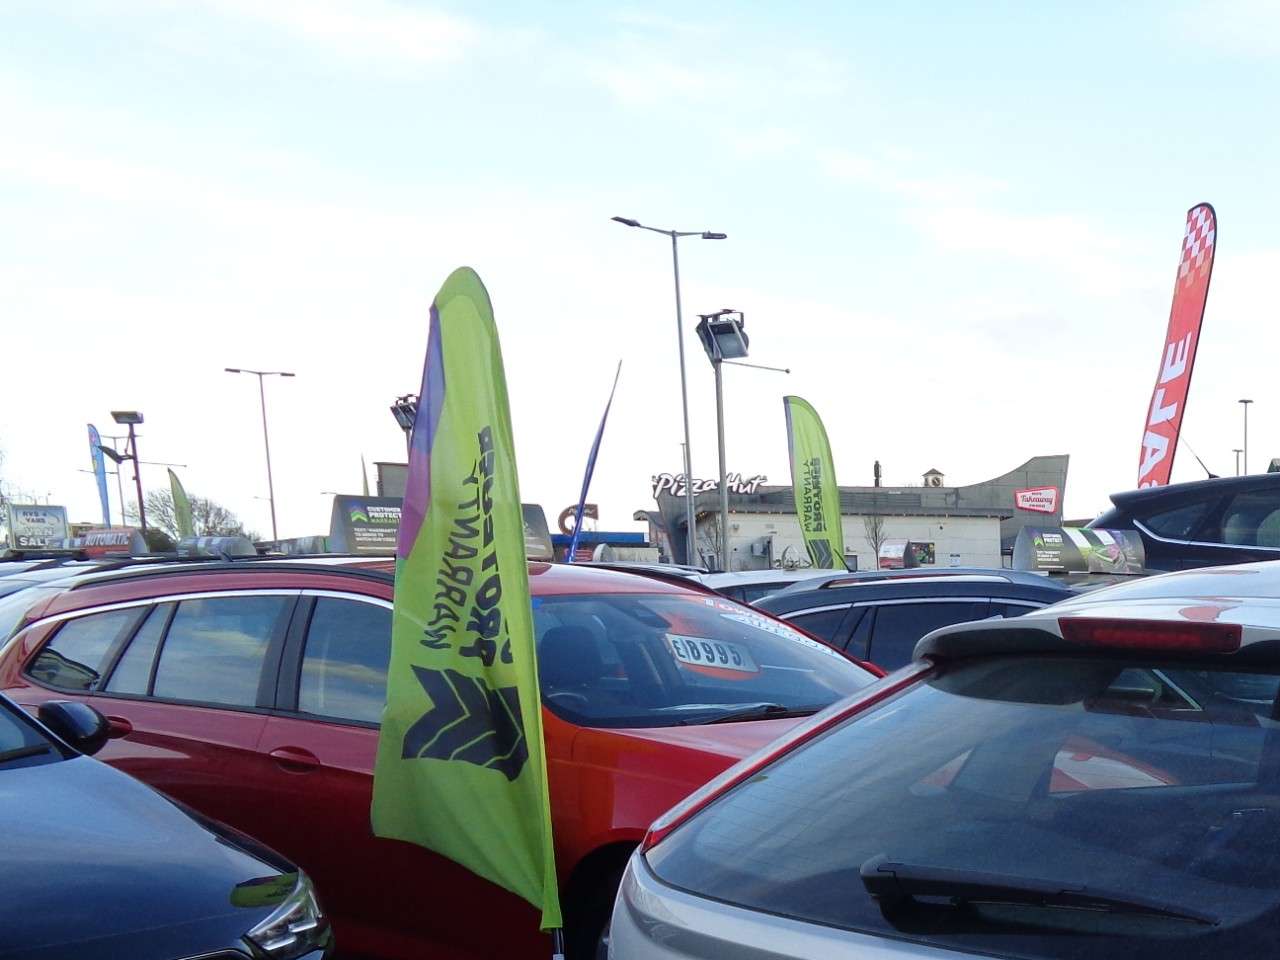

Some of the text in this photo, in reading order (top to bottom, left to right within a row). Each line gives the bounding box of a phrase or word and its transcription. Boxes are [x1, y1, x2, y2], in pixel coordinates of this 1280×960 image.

[652, 472, 768, 500] Pizza Hut
[1021, 495, 1053, 504] Takeaway
